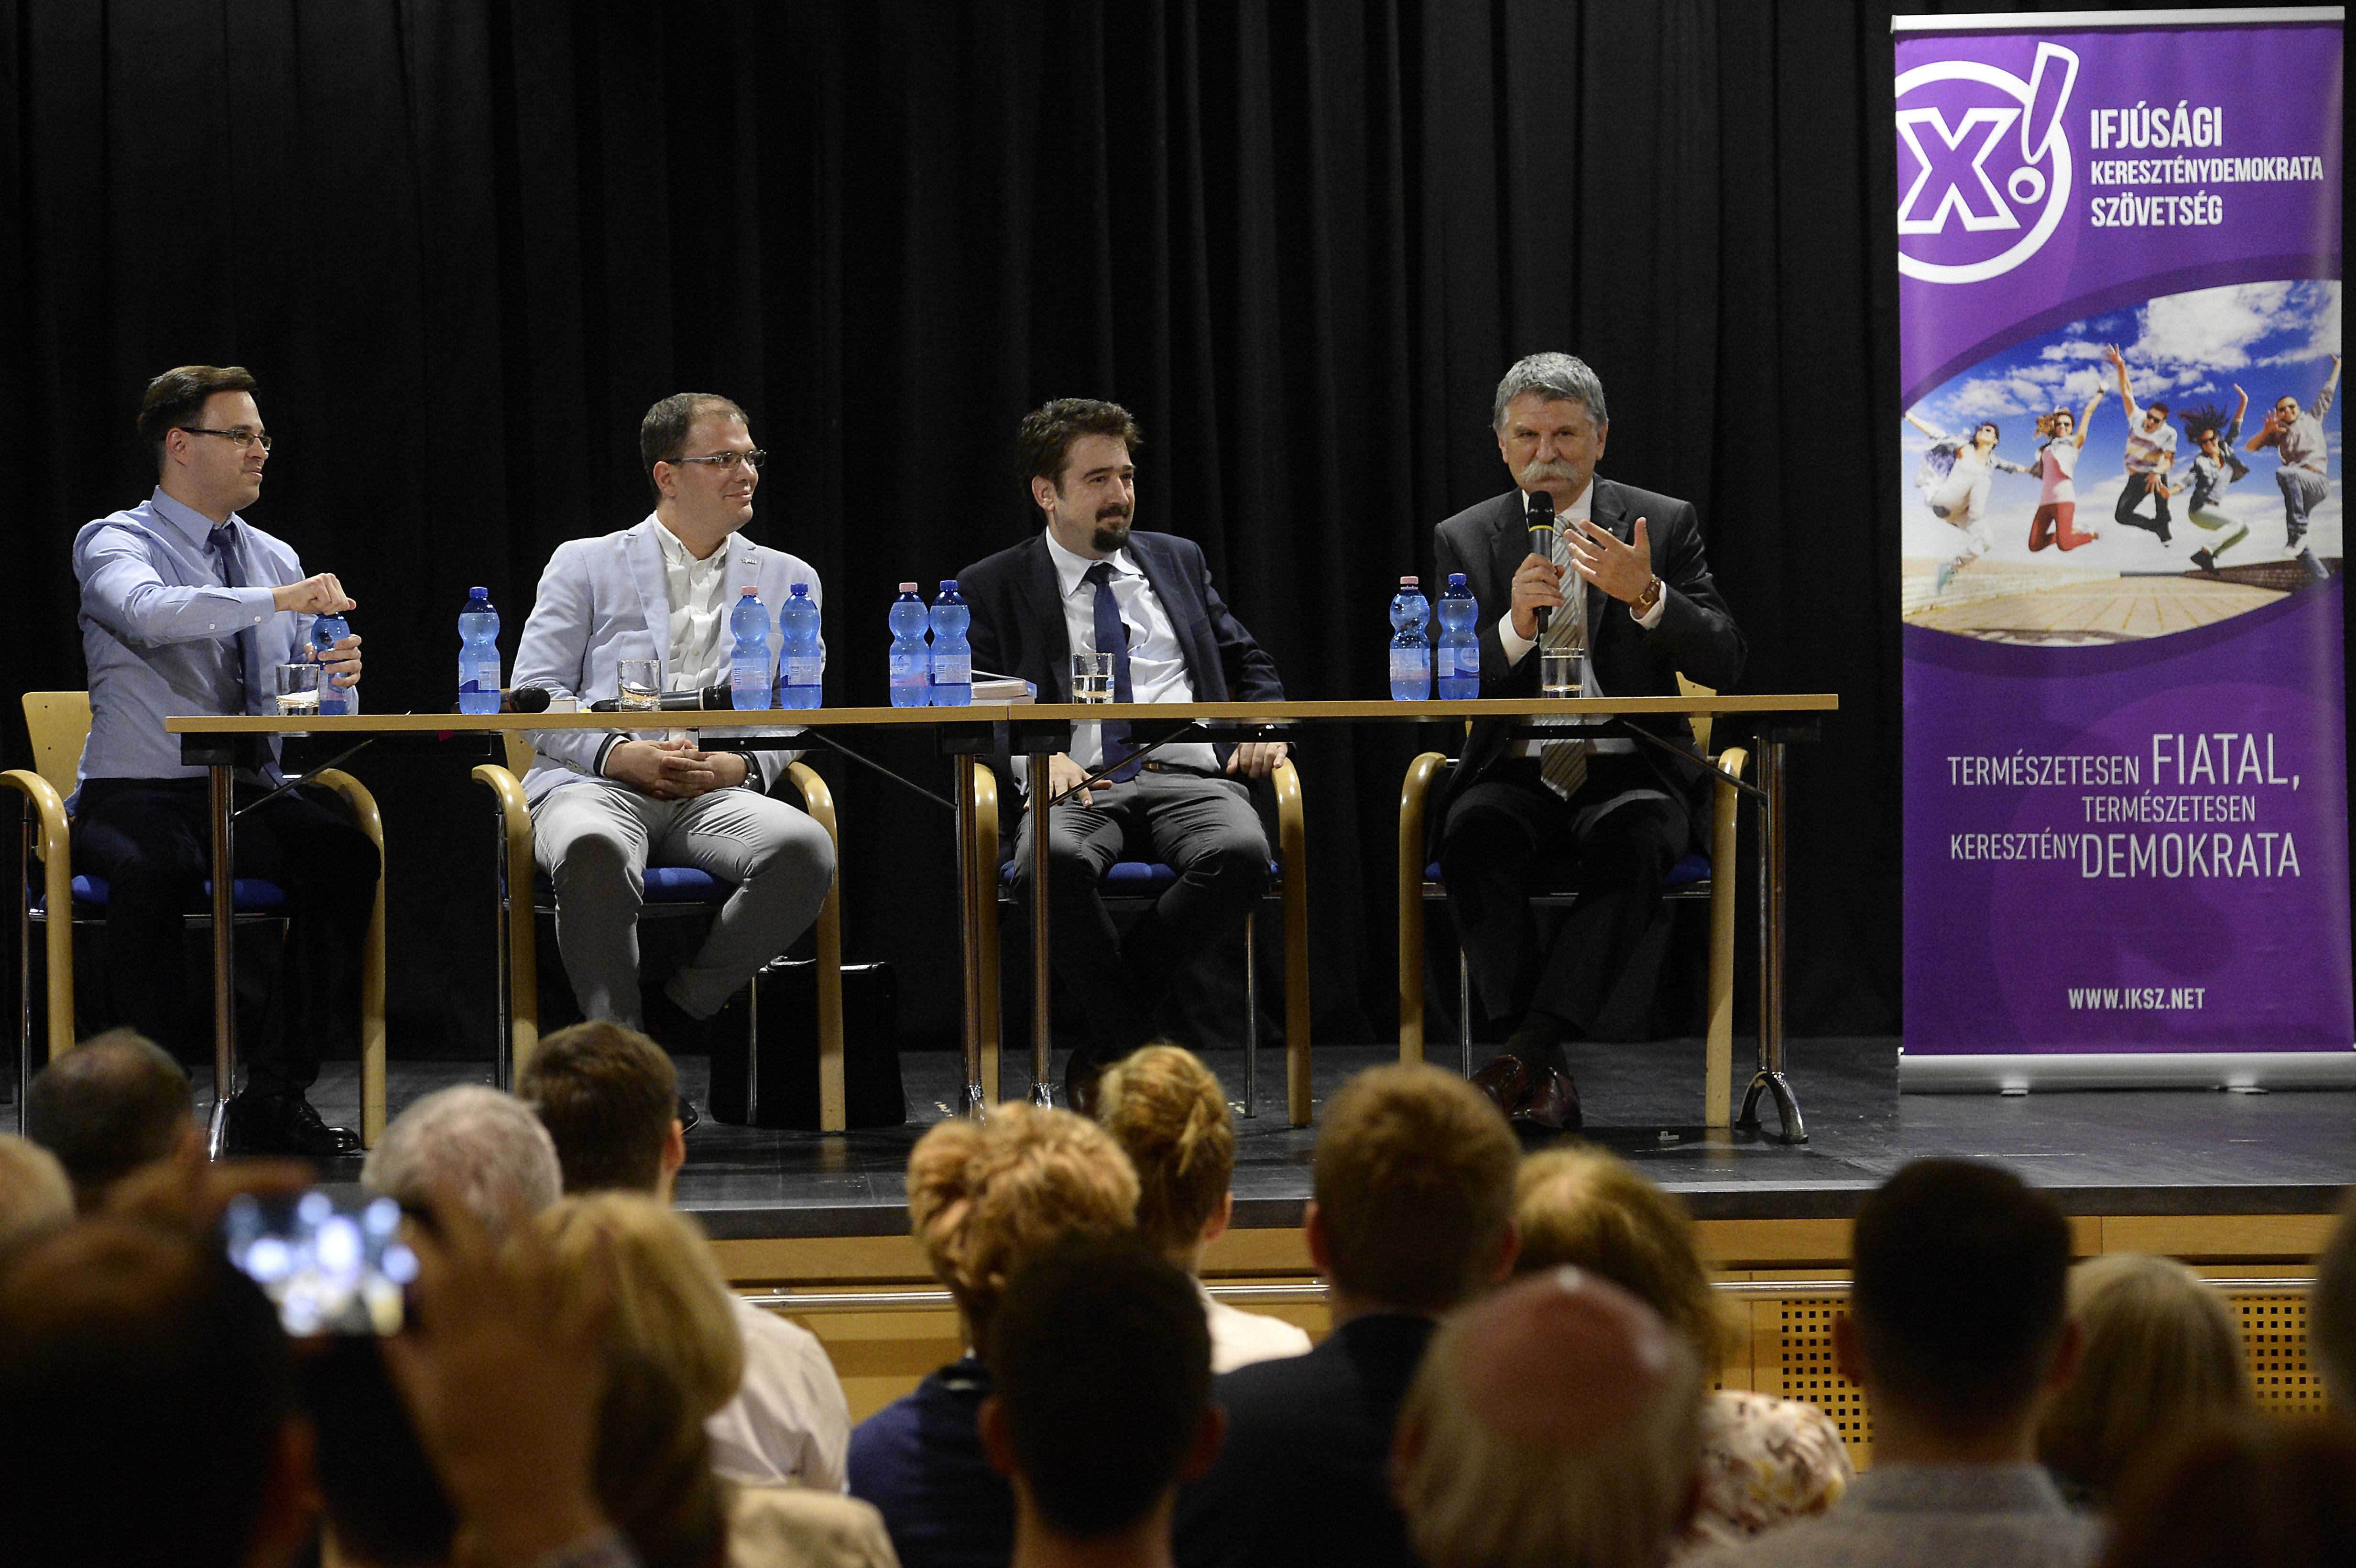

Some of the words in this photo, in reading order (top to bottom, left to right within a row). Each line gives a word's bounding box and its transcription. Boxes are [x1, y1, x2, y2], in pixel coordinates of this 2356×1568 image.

[2091, 99, 2222, 149] IFJÚSÁGI
[2091, 154, 2323, 185] KERESZTÉNYDEMOKRATA
[2091, 190, 2223, 227] SZÖVETSÉG
[1947, 749, 2139, 785] TERMÉSZETESEN
[2152, 733, 2300, 791] FIATAL,
[2082, 789, 2255, 823] TERMÉSZETESEN
[2068, 987, 2205, 1010] WWW.IKSZ.NET
